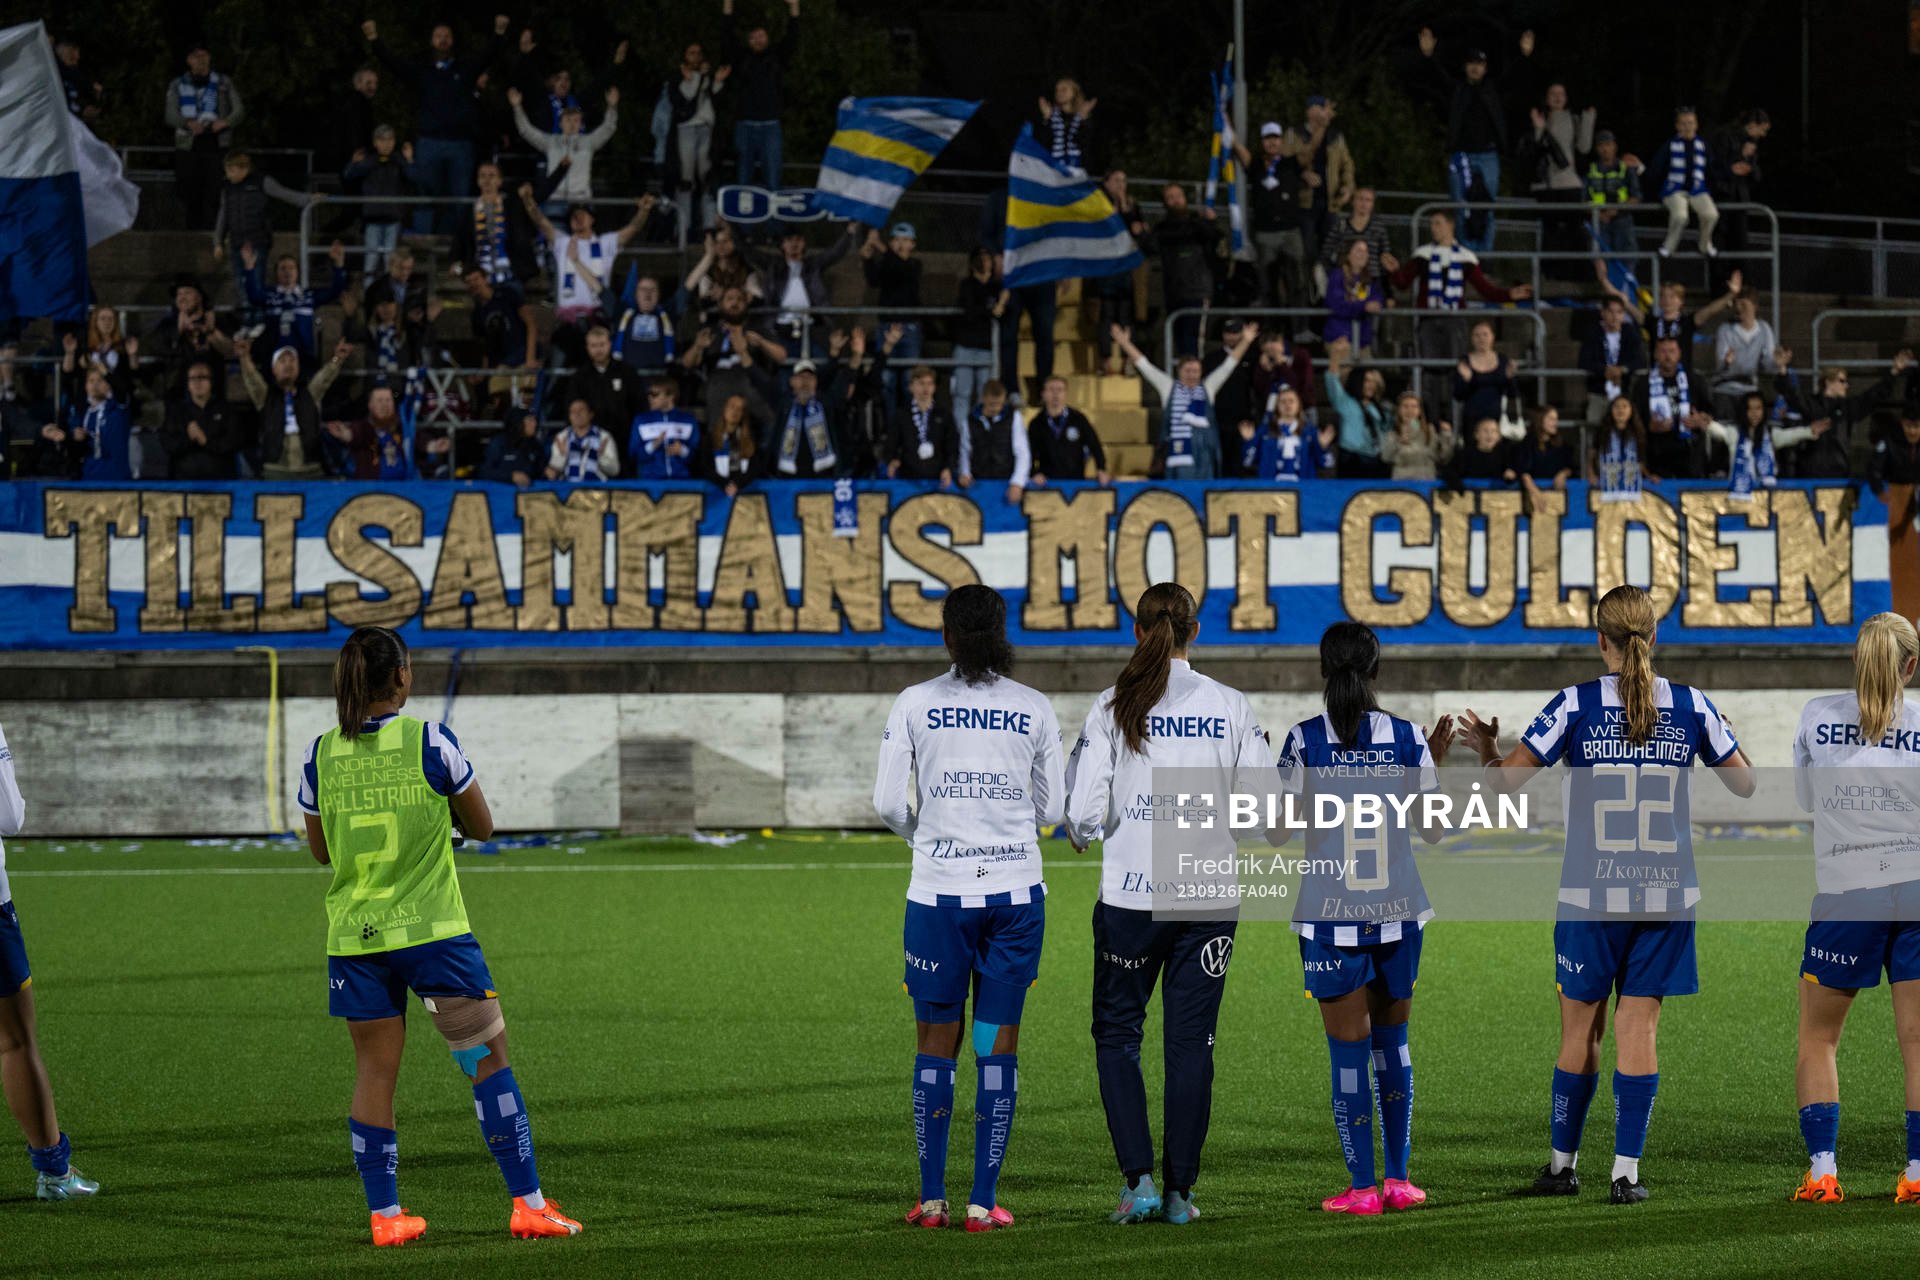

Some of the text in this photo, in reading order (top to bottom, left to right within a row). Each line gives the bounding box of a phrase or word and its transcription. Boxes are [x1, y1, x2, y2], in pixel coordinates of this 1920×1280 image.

[44, 488, 1859, 633] TILLSAMMANS MOT GULDEN
[927, 707, 1031, 735] SERNEKE
[1144, 715, 1226, 739] RNEKE
[1588, 724, 1686, 741] WELESS
[1816, 723, 1920, 753] SEREKE
[1331, 749, 1394, 764] NORDIC
[1582, 739, 1691, 763] BRODDHEIMER
[335, 753, 402, 773] NORDIC
[1315, 764, 1405, 779] WELLNESS
[323, 766, 420, 790] WELLNESS
[943, 771, 1008, 787] NORDIC
[322, 782, 427, 815] HELLSTRÖM
[928, 785, 1023, 801] WELLNESS
[1136, 793, 1205, 808] NORDIC
[1835, 784, 1900, 799] NORDIC
[1124, 807, 1218, 822] WELLNESS
[1592, 762, 1680, 854] 22
[1821, 797, 1915, 812] WELLNESS
[349, 811, 399, 901] 2
[931, 840, 1026, 859] El KONTAKT
[1343, 801, 1390, 893] 8
[1595, 859, 1680, 880] El KONTAKT
[1122, 871, 1144, 893] El
[1321, 897, 1410, 919] El KONTAKT
[906, 950, 939, 973] BRIXLY
[1103, 952, 1149, 970] BRIXLY
[1304, 959, 1342, 972] BRIXLY
[1810, 946, 1858, 966] BRIXLY
[988, 1097, 1011, 1168] SILFVERLOK
[1334, 1099, 1358, 1164] SILFVERLOK
